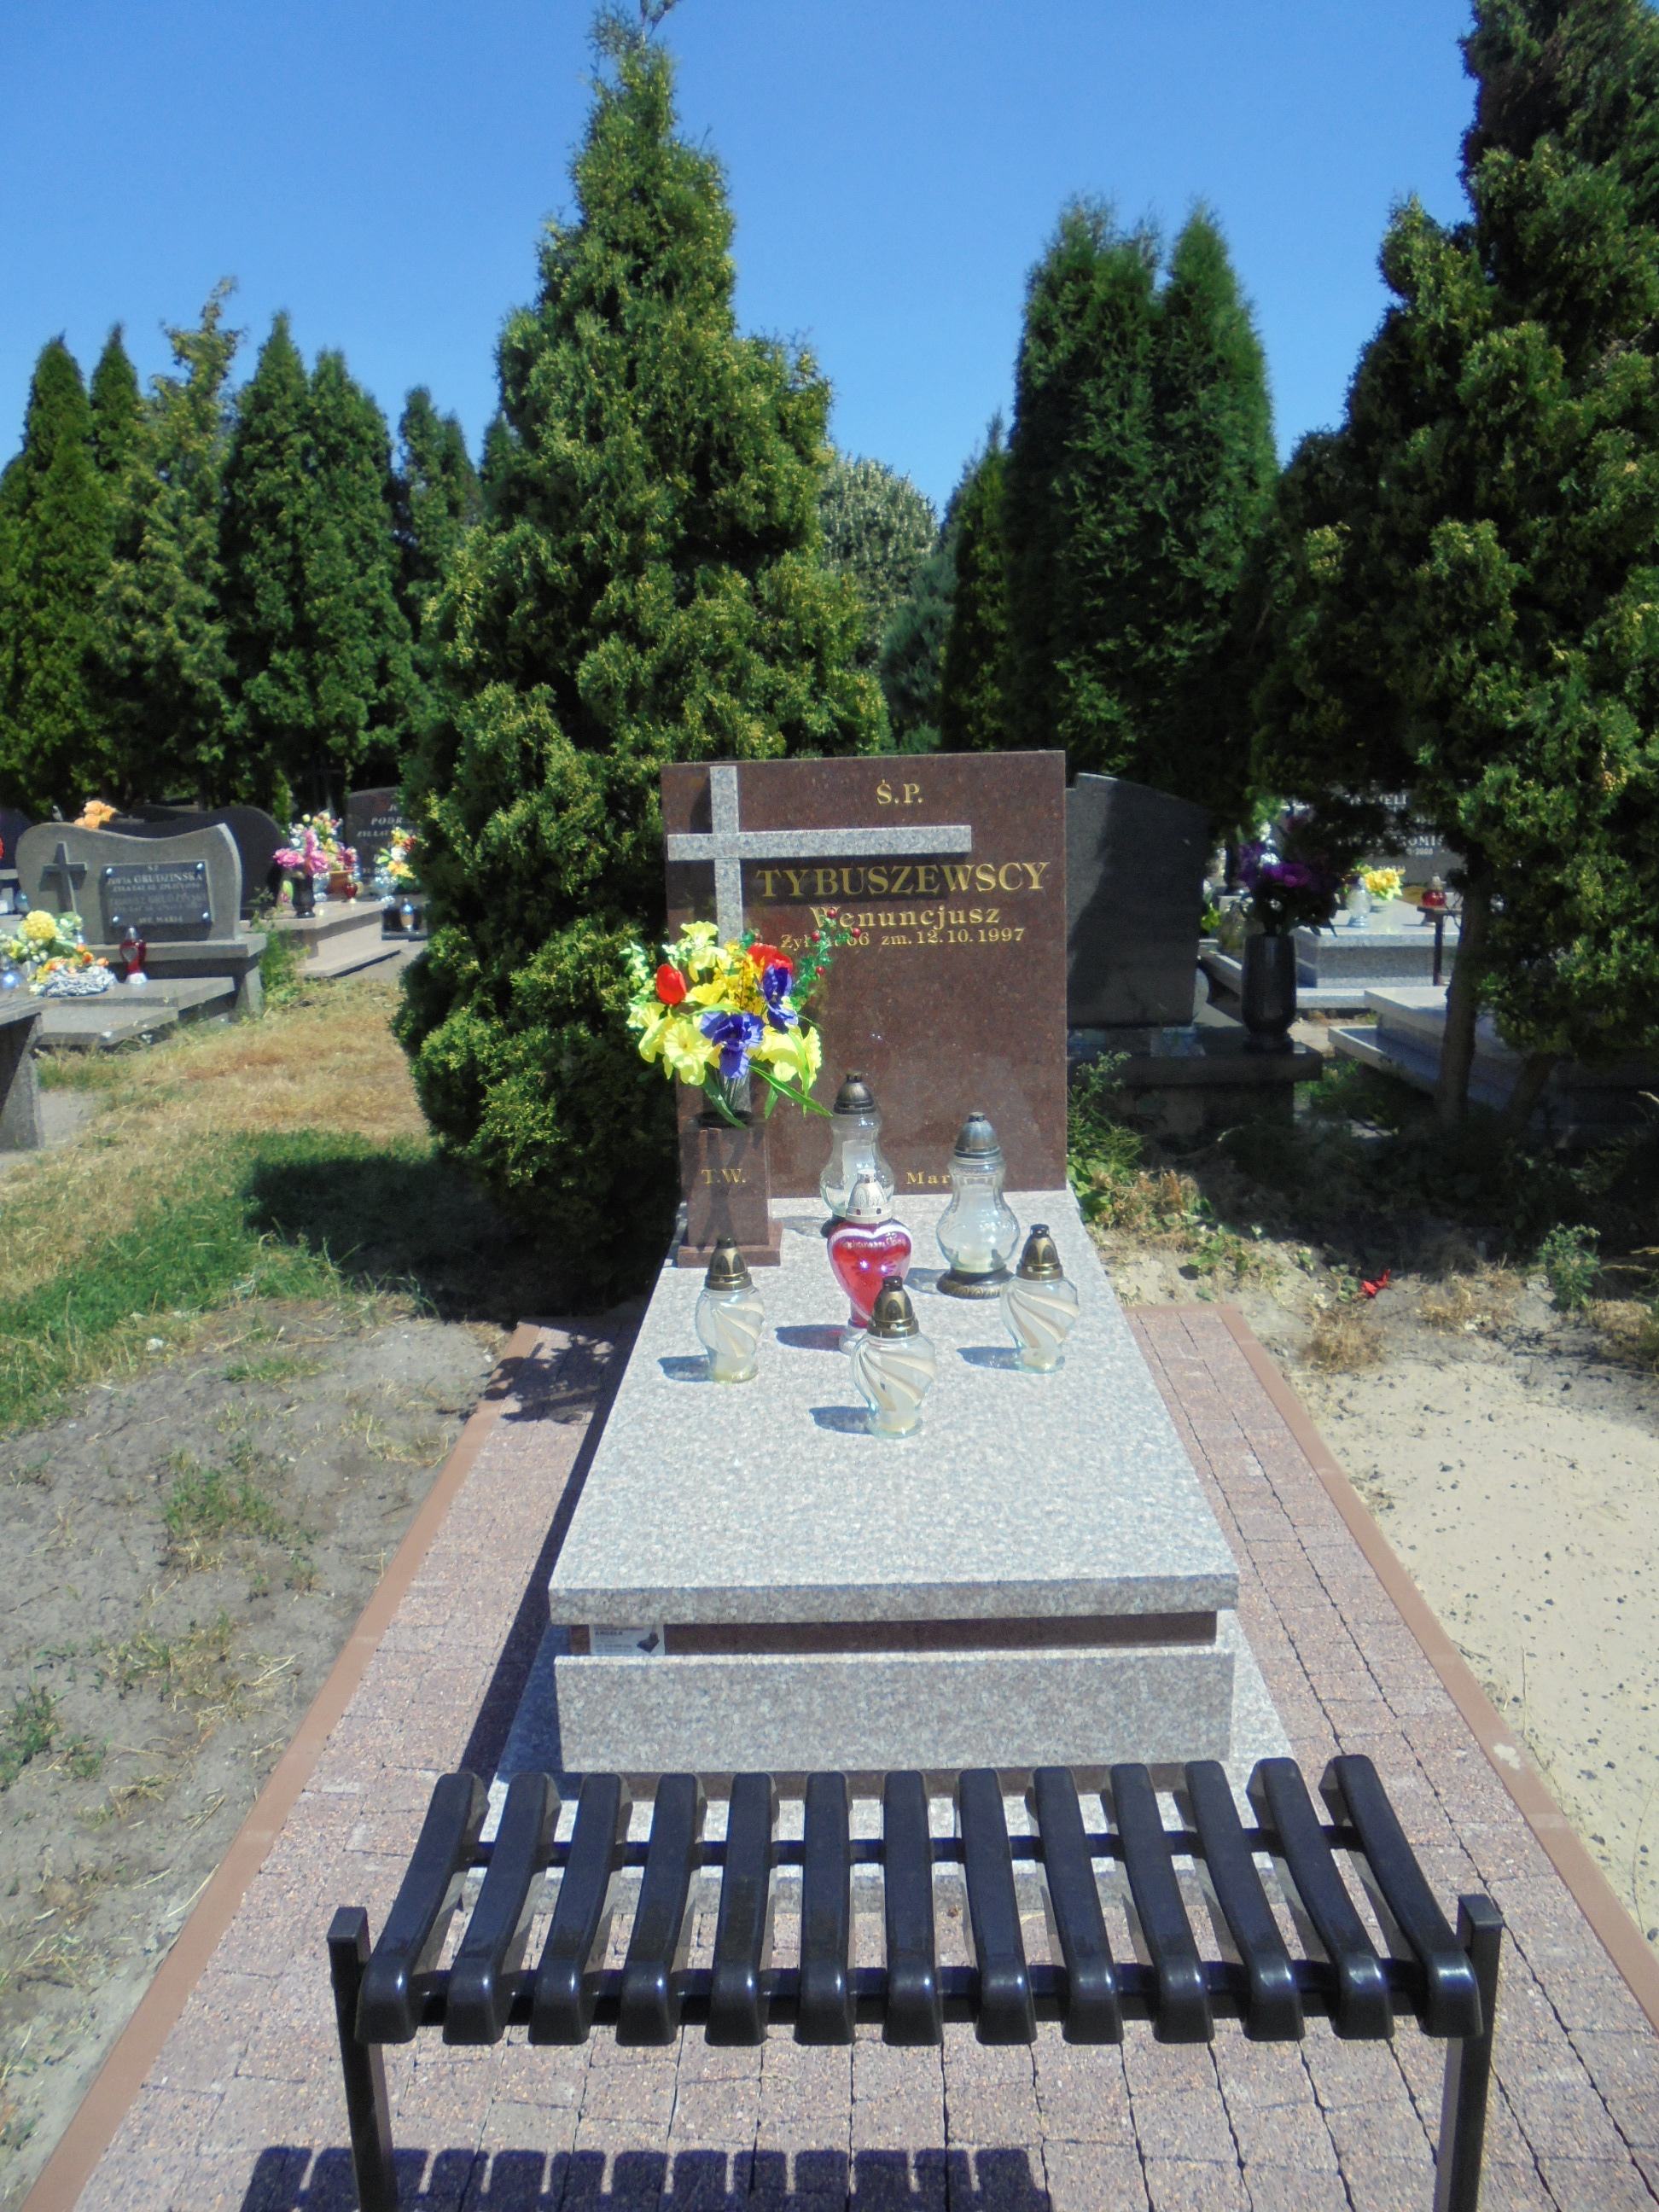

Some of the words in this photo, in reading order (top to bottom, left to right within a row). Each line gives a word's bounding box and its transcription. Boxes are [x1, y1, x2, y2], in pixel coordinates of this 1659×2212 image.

[755, 860, 1051, 897] TYBUSZEWSCY
[809, 905, 1001, 931] Wenuncjusz
[881, 934, 913, 946] zm.
[700, 1167, 747, 1185] T.W.
[905, 1171, 951, 1185] Mar
